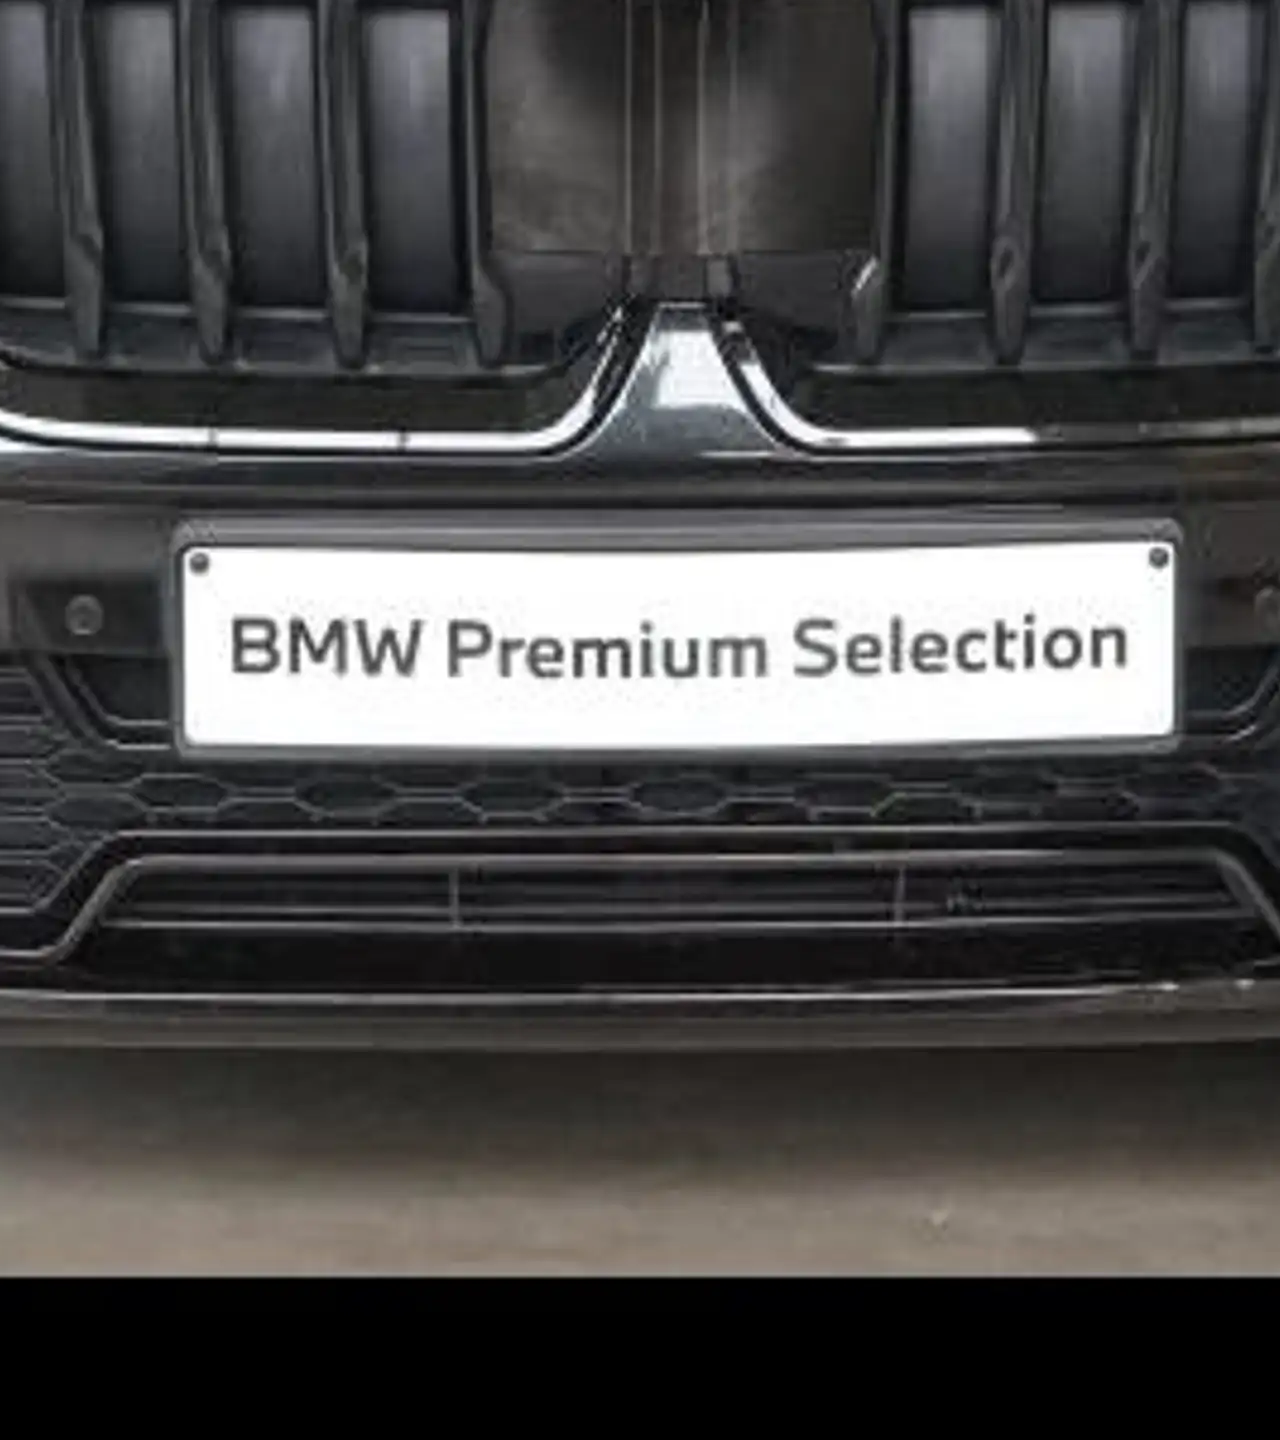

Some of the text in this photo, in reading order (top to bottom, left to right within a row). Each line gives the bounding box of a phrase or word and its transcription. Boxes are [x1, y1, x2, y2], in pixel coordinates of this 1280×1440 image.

[231, 613, 1128, 679] BMW Premium Selection
